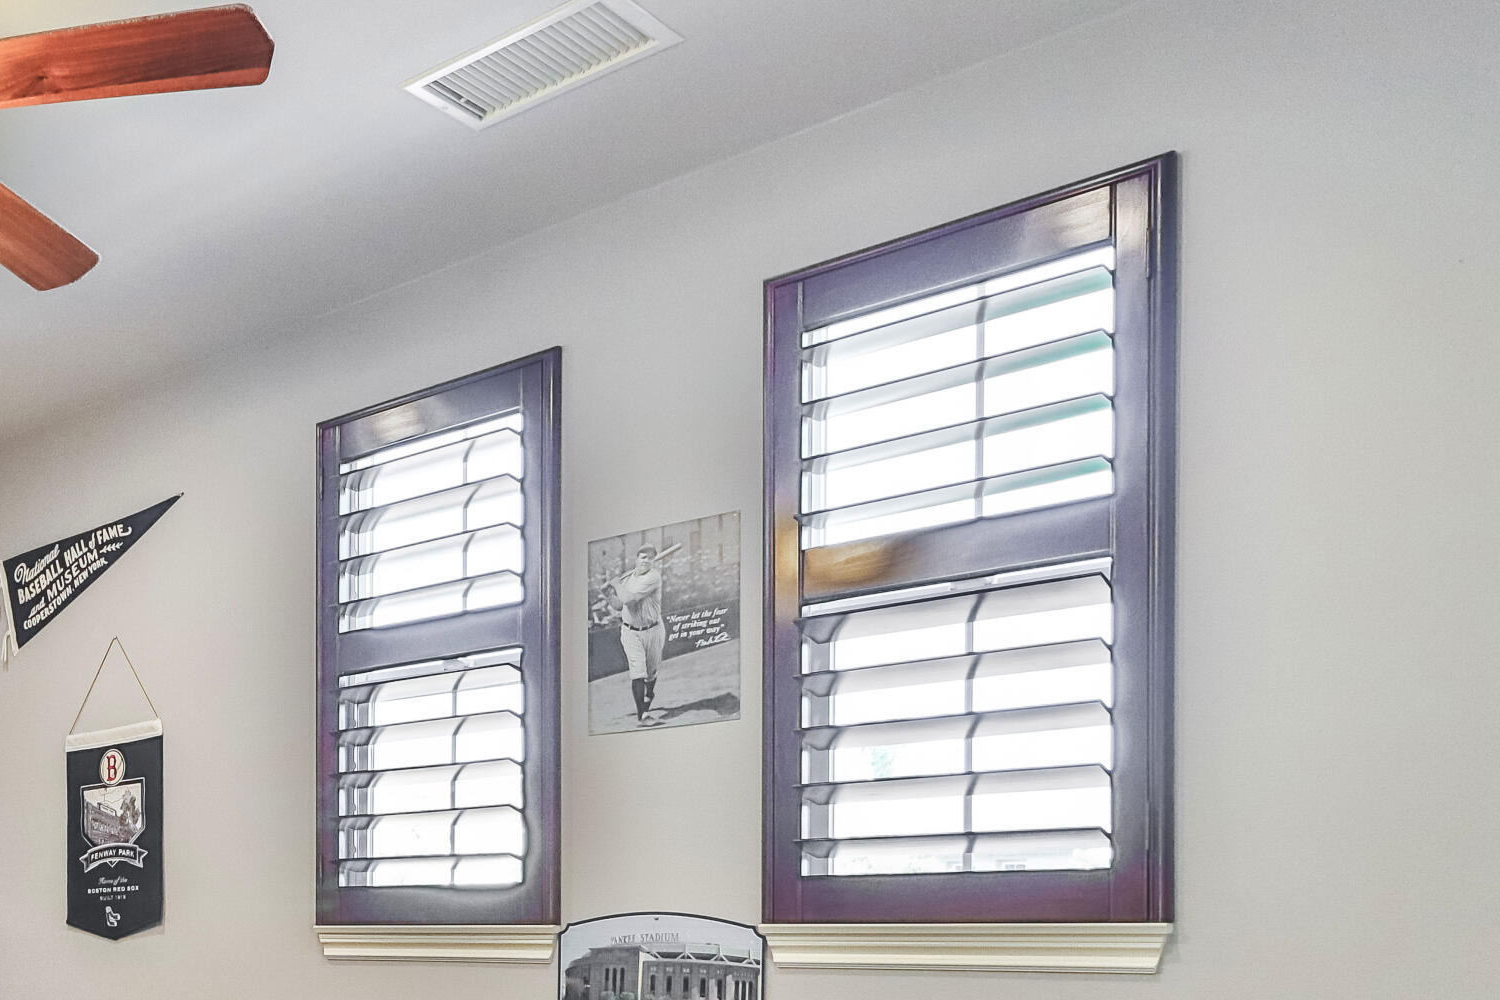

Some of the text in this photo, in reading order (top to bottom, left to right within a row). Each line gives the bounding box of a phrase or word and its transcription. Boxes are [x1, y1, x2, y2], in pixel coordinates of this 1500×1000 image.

[14, 544, 60, 585] National
[17, 524, 132, 604] BASEBALL HALL of FAME
[73, 569, 89, 589] NEW
[88, 556, 108, 574] YORK
[28, 548, 99, 619] and MUSEUM
[106, 754, 117, 781] B
[90, 848, 135, 862] FENWAY PARK
[611, 932, 679, 944] YANKEE STADIUM
